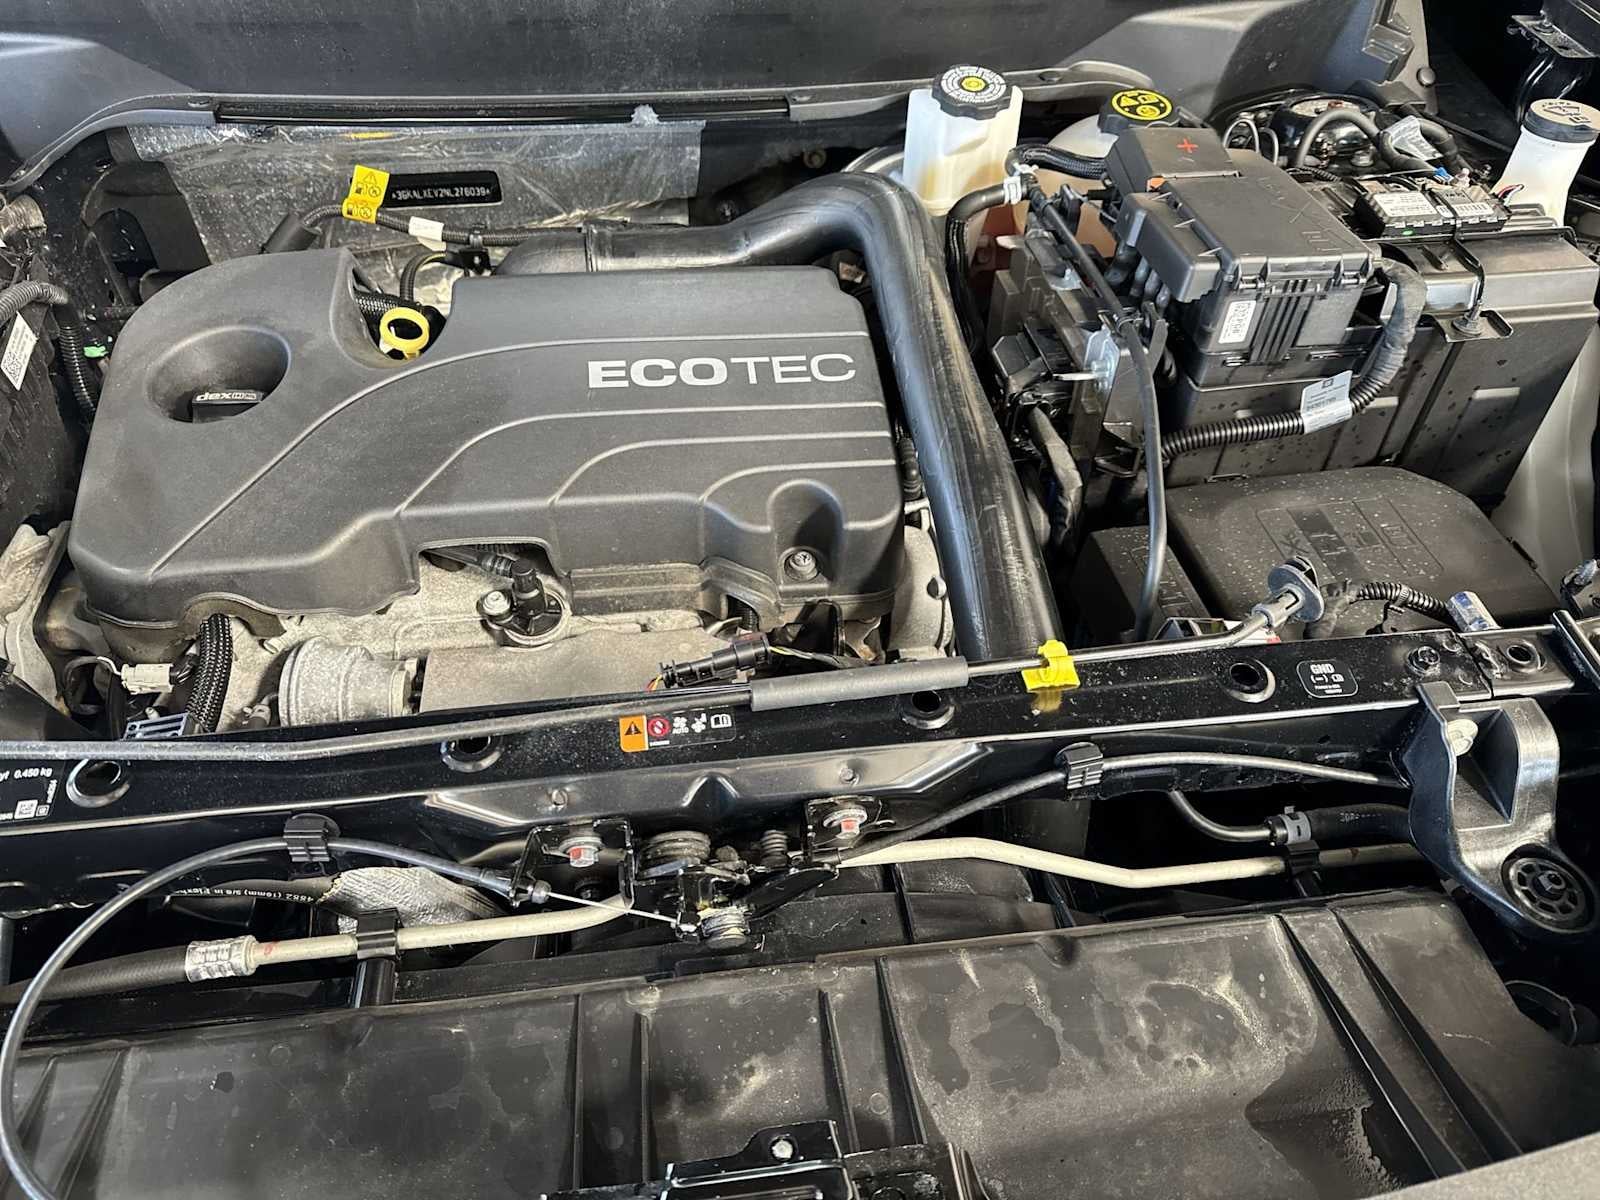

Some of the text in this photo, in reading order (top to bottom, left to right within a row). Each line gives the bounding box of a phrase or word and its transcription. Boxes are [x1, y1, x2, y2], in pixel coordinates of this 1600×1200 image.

[588, 353, 856, 388] ECOTEC
[1310, 663, 1335, 674] GND
[14, 768, 39, 779] 0.450
[40, 767, 53, 777] kg
